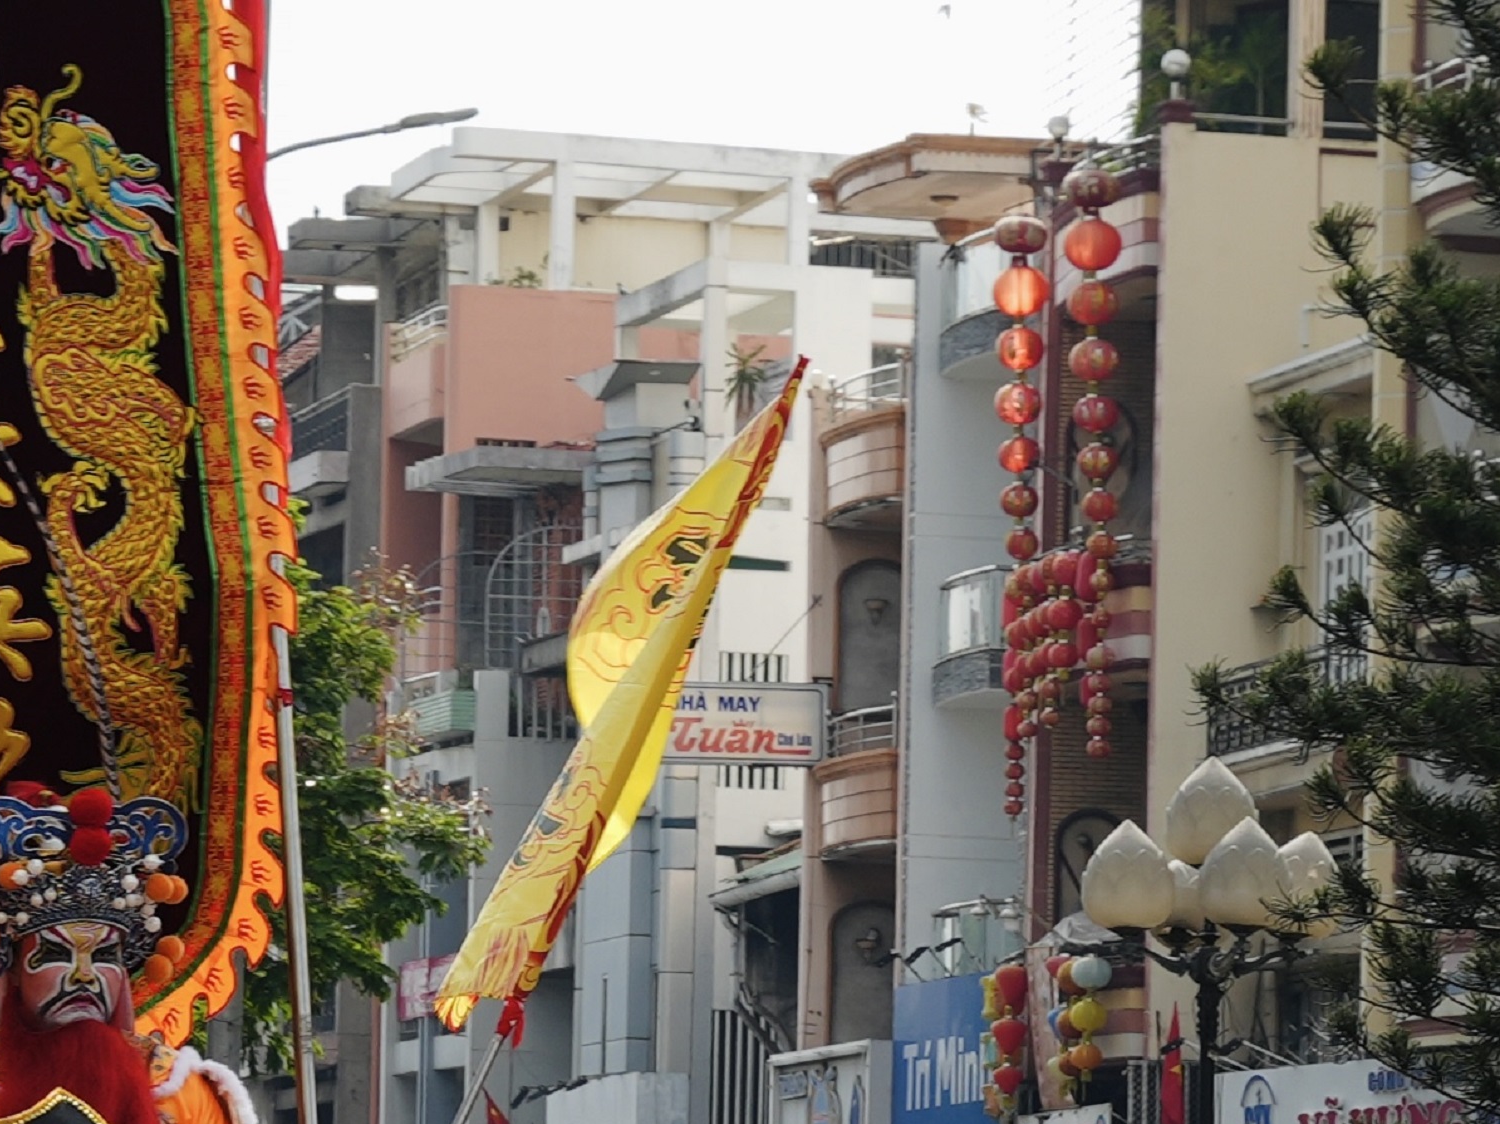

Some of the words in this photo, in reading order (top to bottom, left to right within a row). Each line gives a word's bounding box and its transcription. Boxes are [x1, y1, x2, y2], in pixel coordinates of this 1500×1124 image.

[676, 691, 707, 712] HÀ
[718, 696, 761, 712] MAY
[902, 1040, 932, 1112] Trí
